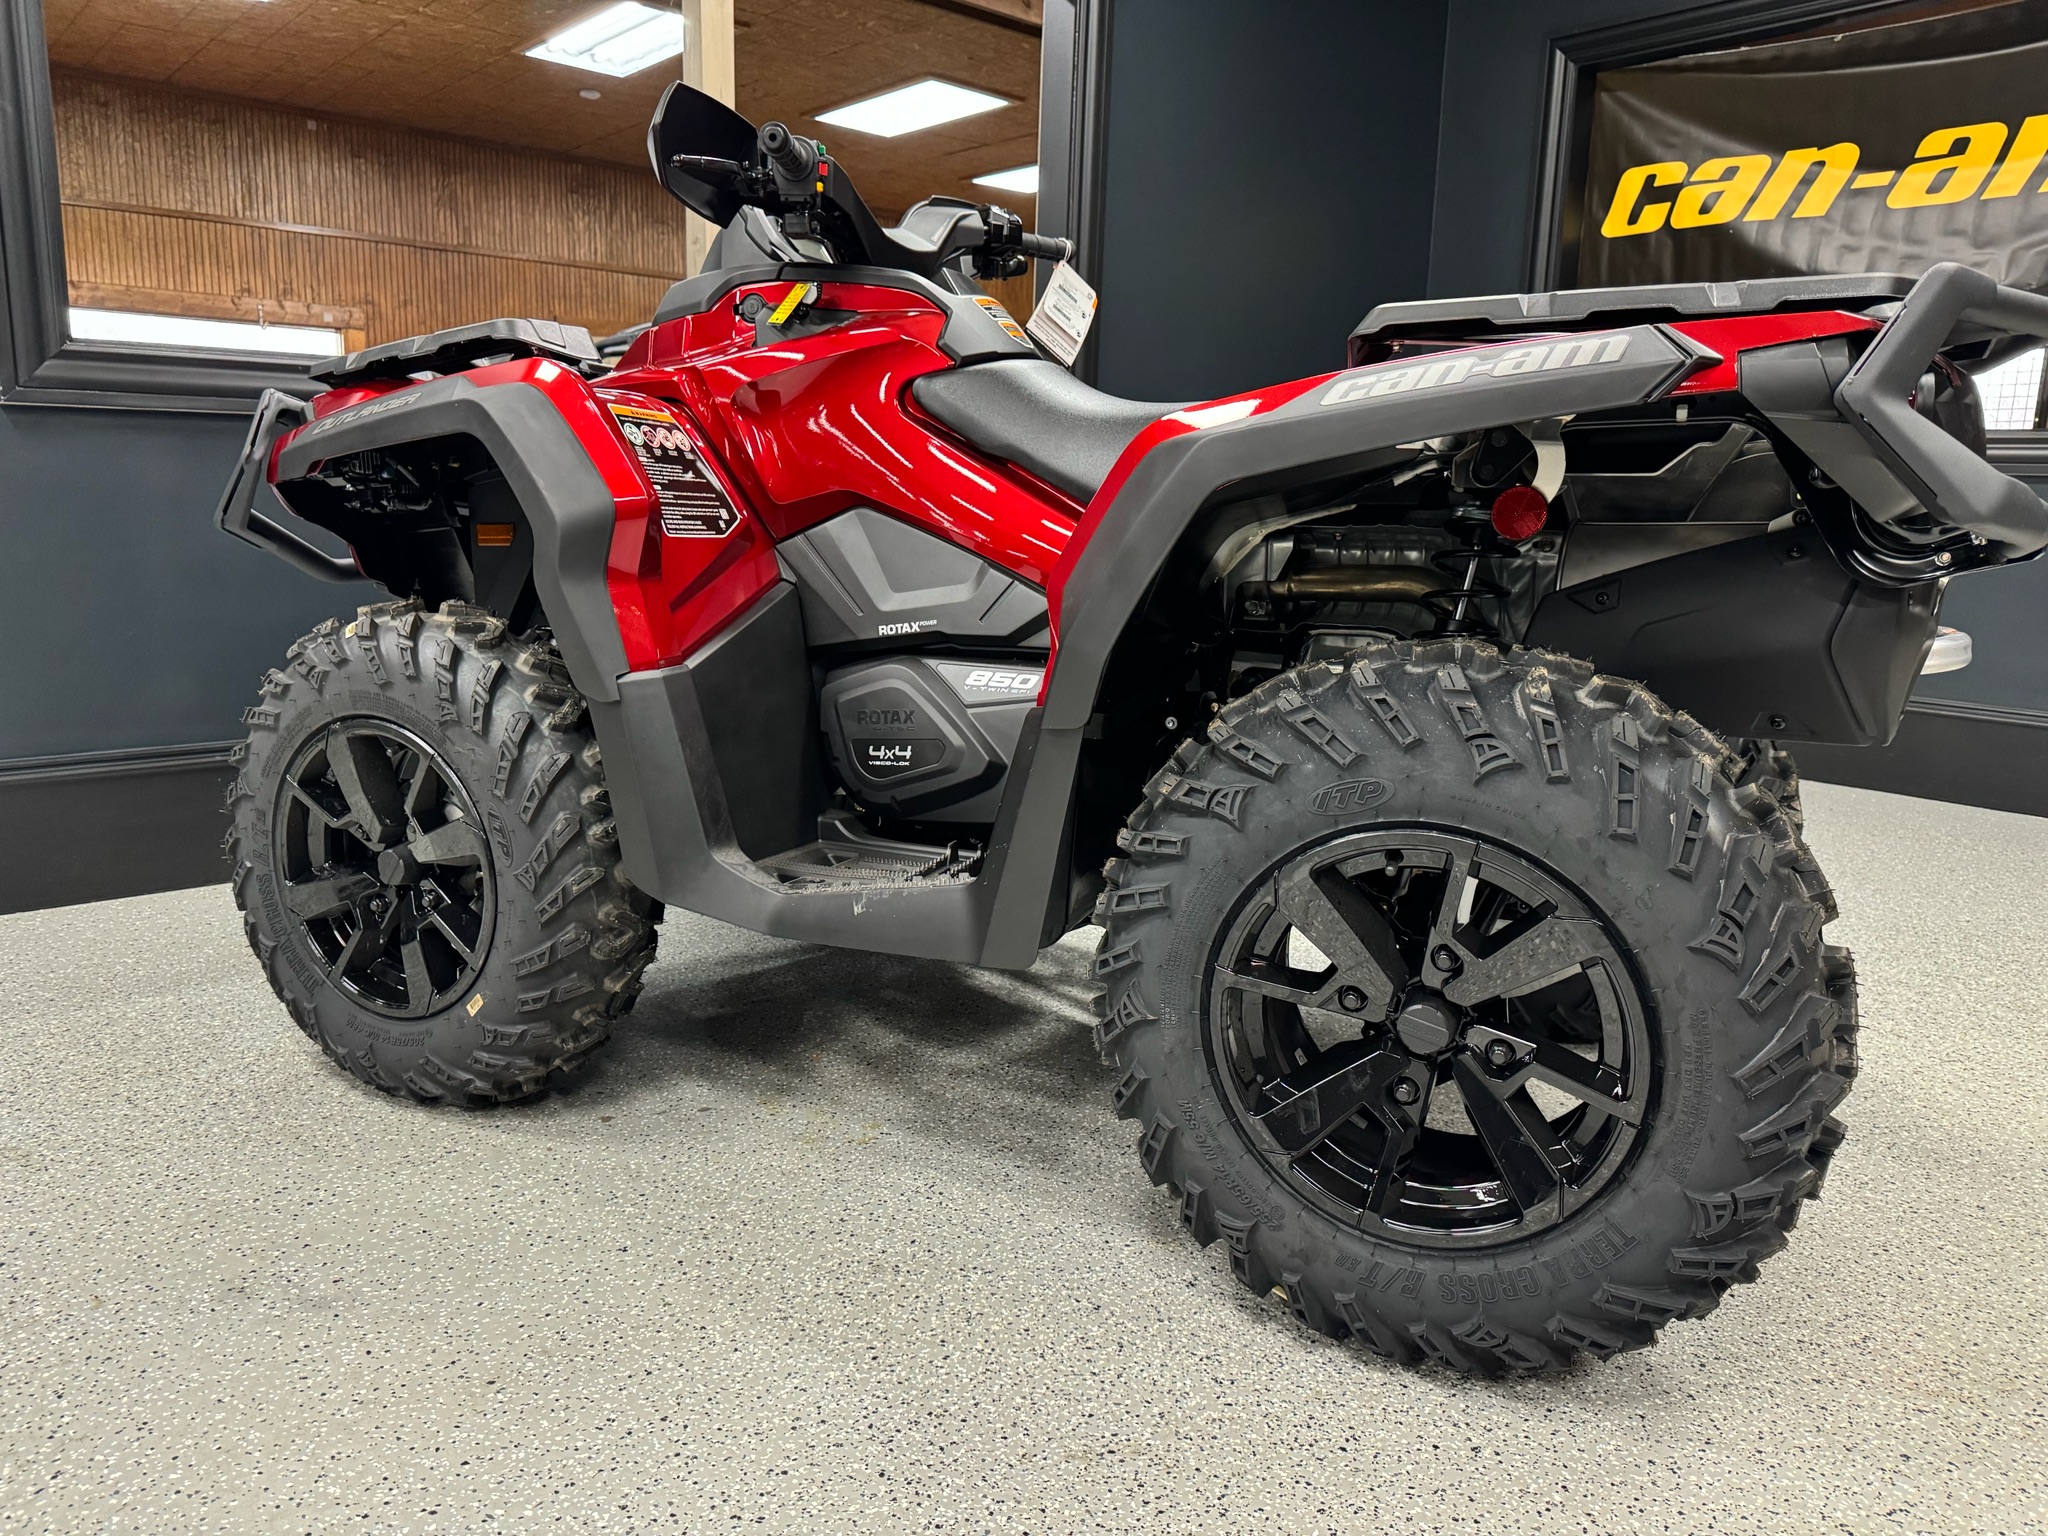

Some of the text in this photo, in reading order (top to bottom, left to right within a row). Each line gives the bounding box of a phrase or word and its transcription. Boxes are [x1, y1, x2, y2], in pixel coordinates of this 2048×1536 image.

[1320, 335, 1632, 406] can-am
[312, 392, 423, 435] OUTLANDER
[878, 619, 937, 637] ROTAX POWER
[964, 670, 1040, 689] 850
[857, 708, 916, 725] ROTAX
[868, 745, 912, 760] 4x4
[1315, 779, 1385, 813] ITP
[487, 808, 511, 861] ITP
[1545, 1219, 1641, 1288] TERRA
[1357, 1261, 1427, 1299] R/T
[1437, 1264, 1543, 1304] CROSS
